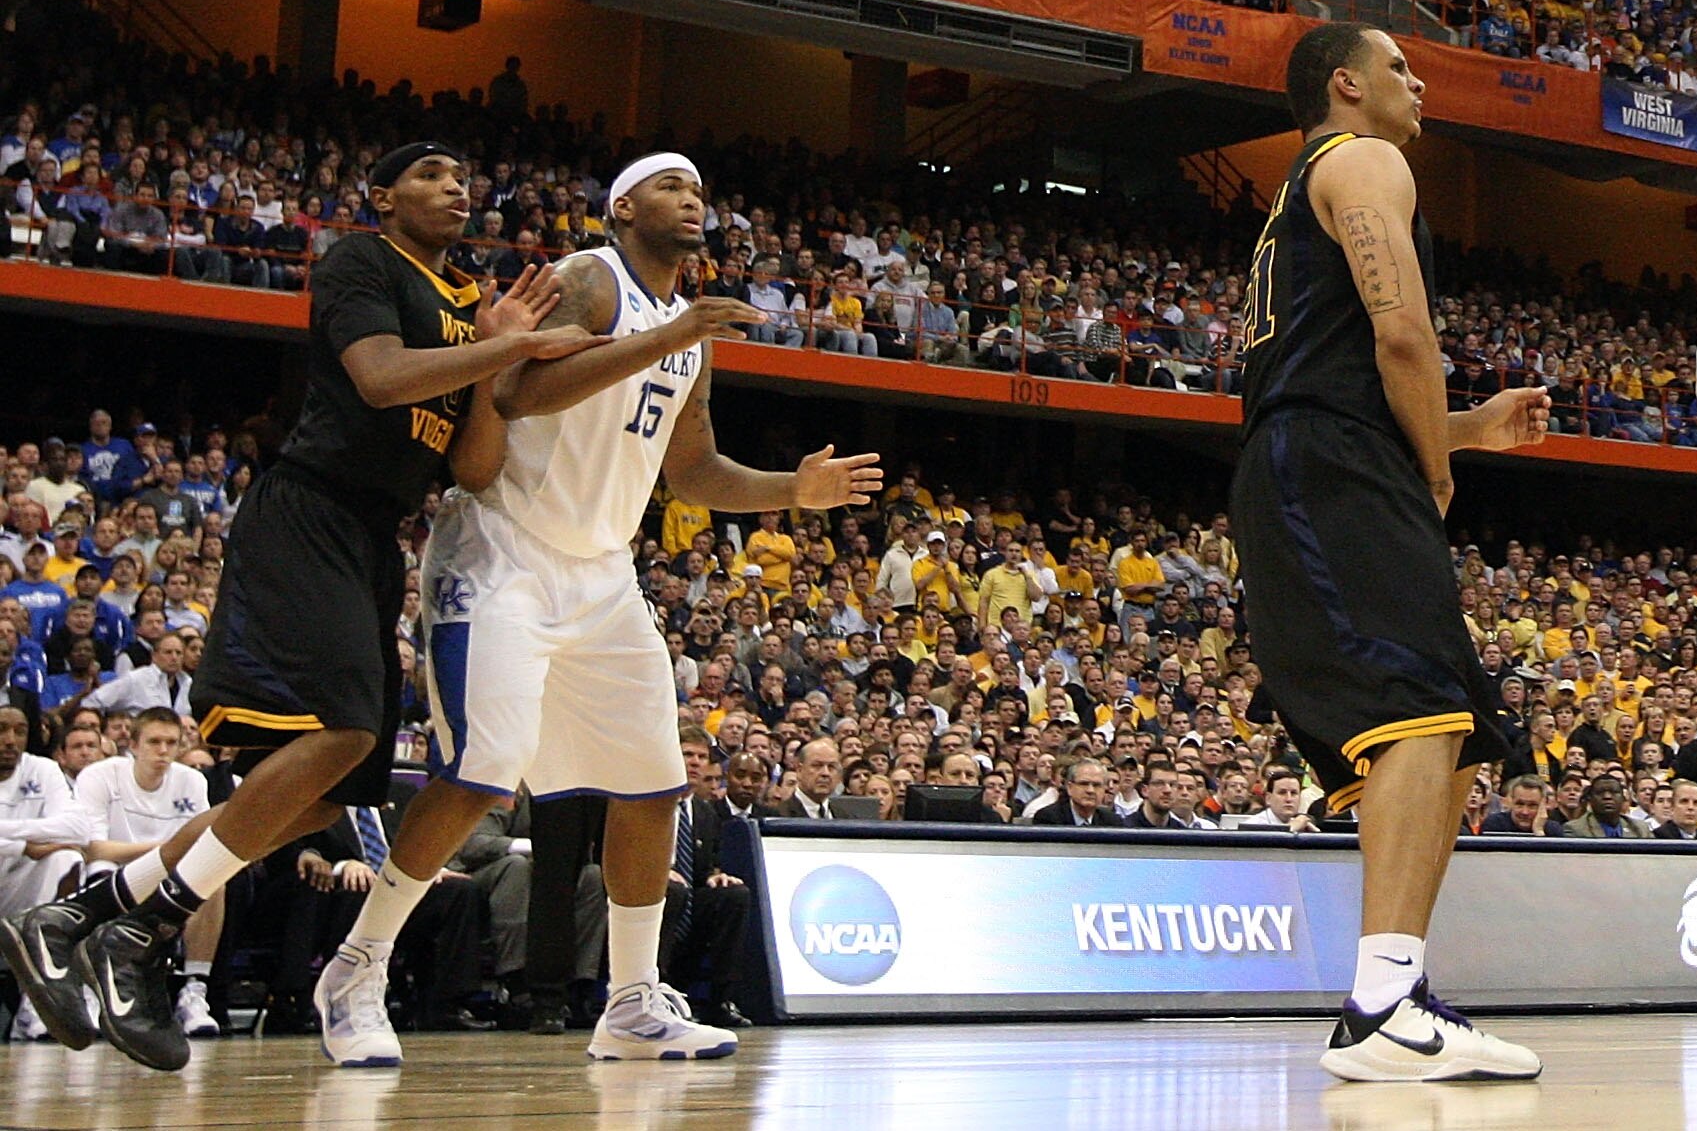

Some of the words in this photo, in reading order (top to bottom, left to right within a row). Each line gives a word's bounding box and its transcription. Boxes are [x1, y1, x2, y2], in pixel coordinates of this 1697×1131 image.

[1172, 12, 1226, 36] NCAA
[1501, 70, 1546, 94] NCAA
[1633, 91, 1673, 116] WEST
[1622, 106, 1684, 138] VIRGINIA
[1010, 377, 1049, 405] 109
[625, 380, 677, 439] 15
[803, 922, 899, 955] NCAA
[1072, 902, 1294, 952] KENTUCKY
